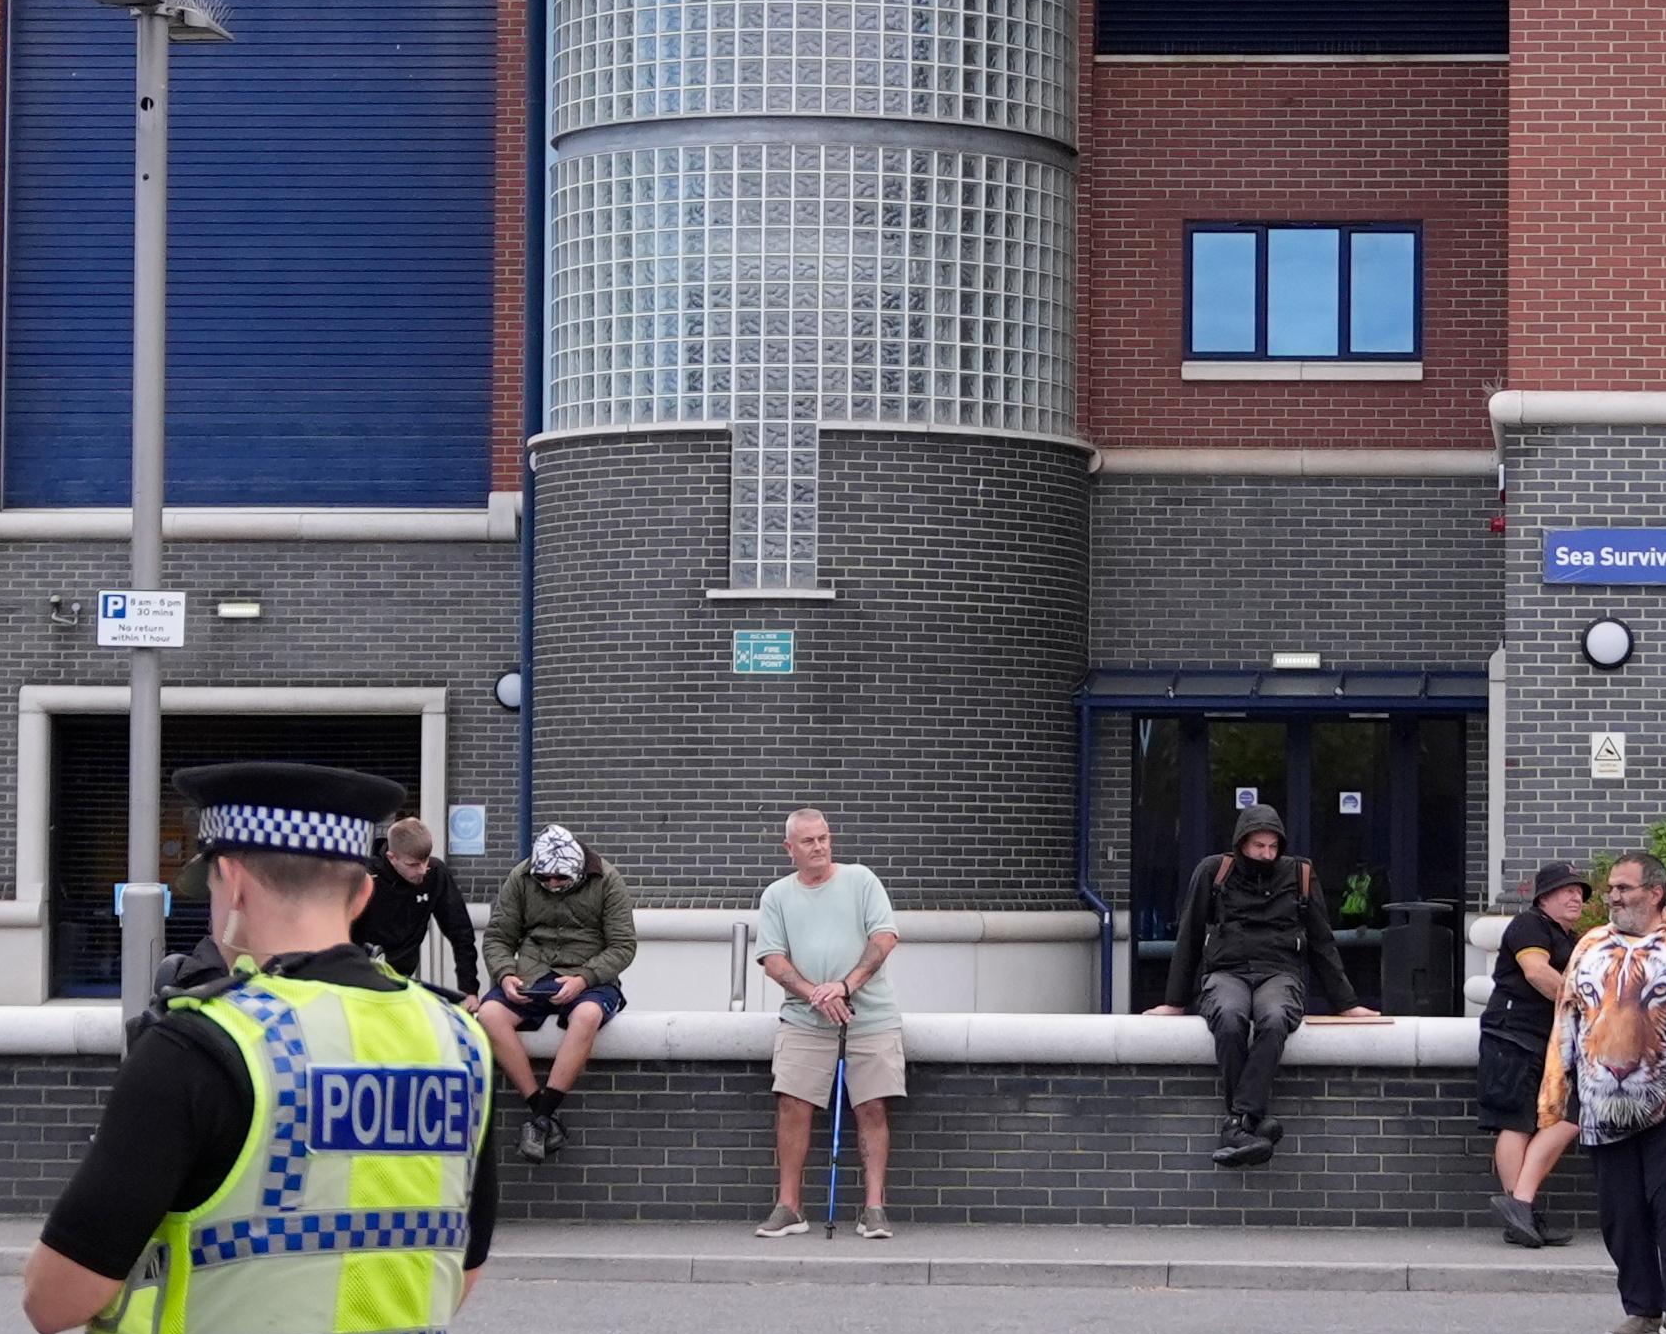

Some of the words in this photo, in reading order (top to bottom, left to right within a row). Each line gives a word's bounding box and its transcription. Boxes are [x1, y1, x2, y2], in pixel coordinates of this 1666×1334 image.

[1555, 546, 1595, 566] Sea
[107, 596, 124, 617] P
[159, 598, 165, 607] 6
[167, 599, 182, 607] pm
[136, 608, 150, 616] 30
[151, 608, 174, 616] mins
[118, 624, 132, 632] No
[134, 624, 164, 632] return
[110, 634, 139, 642] within
[149, 634, 171, 642] hour
[322, 1073, 463, 1146] POLICE
